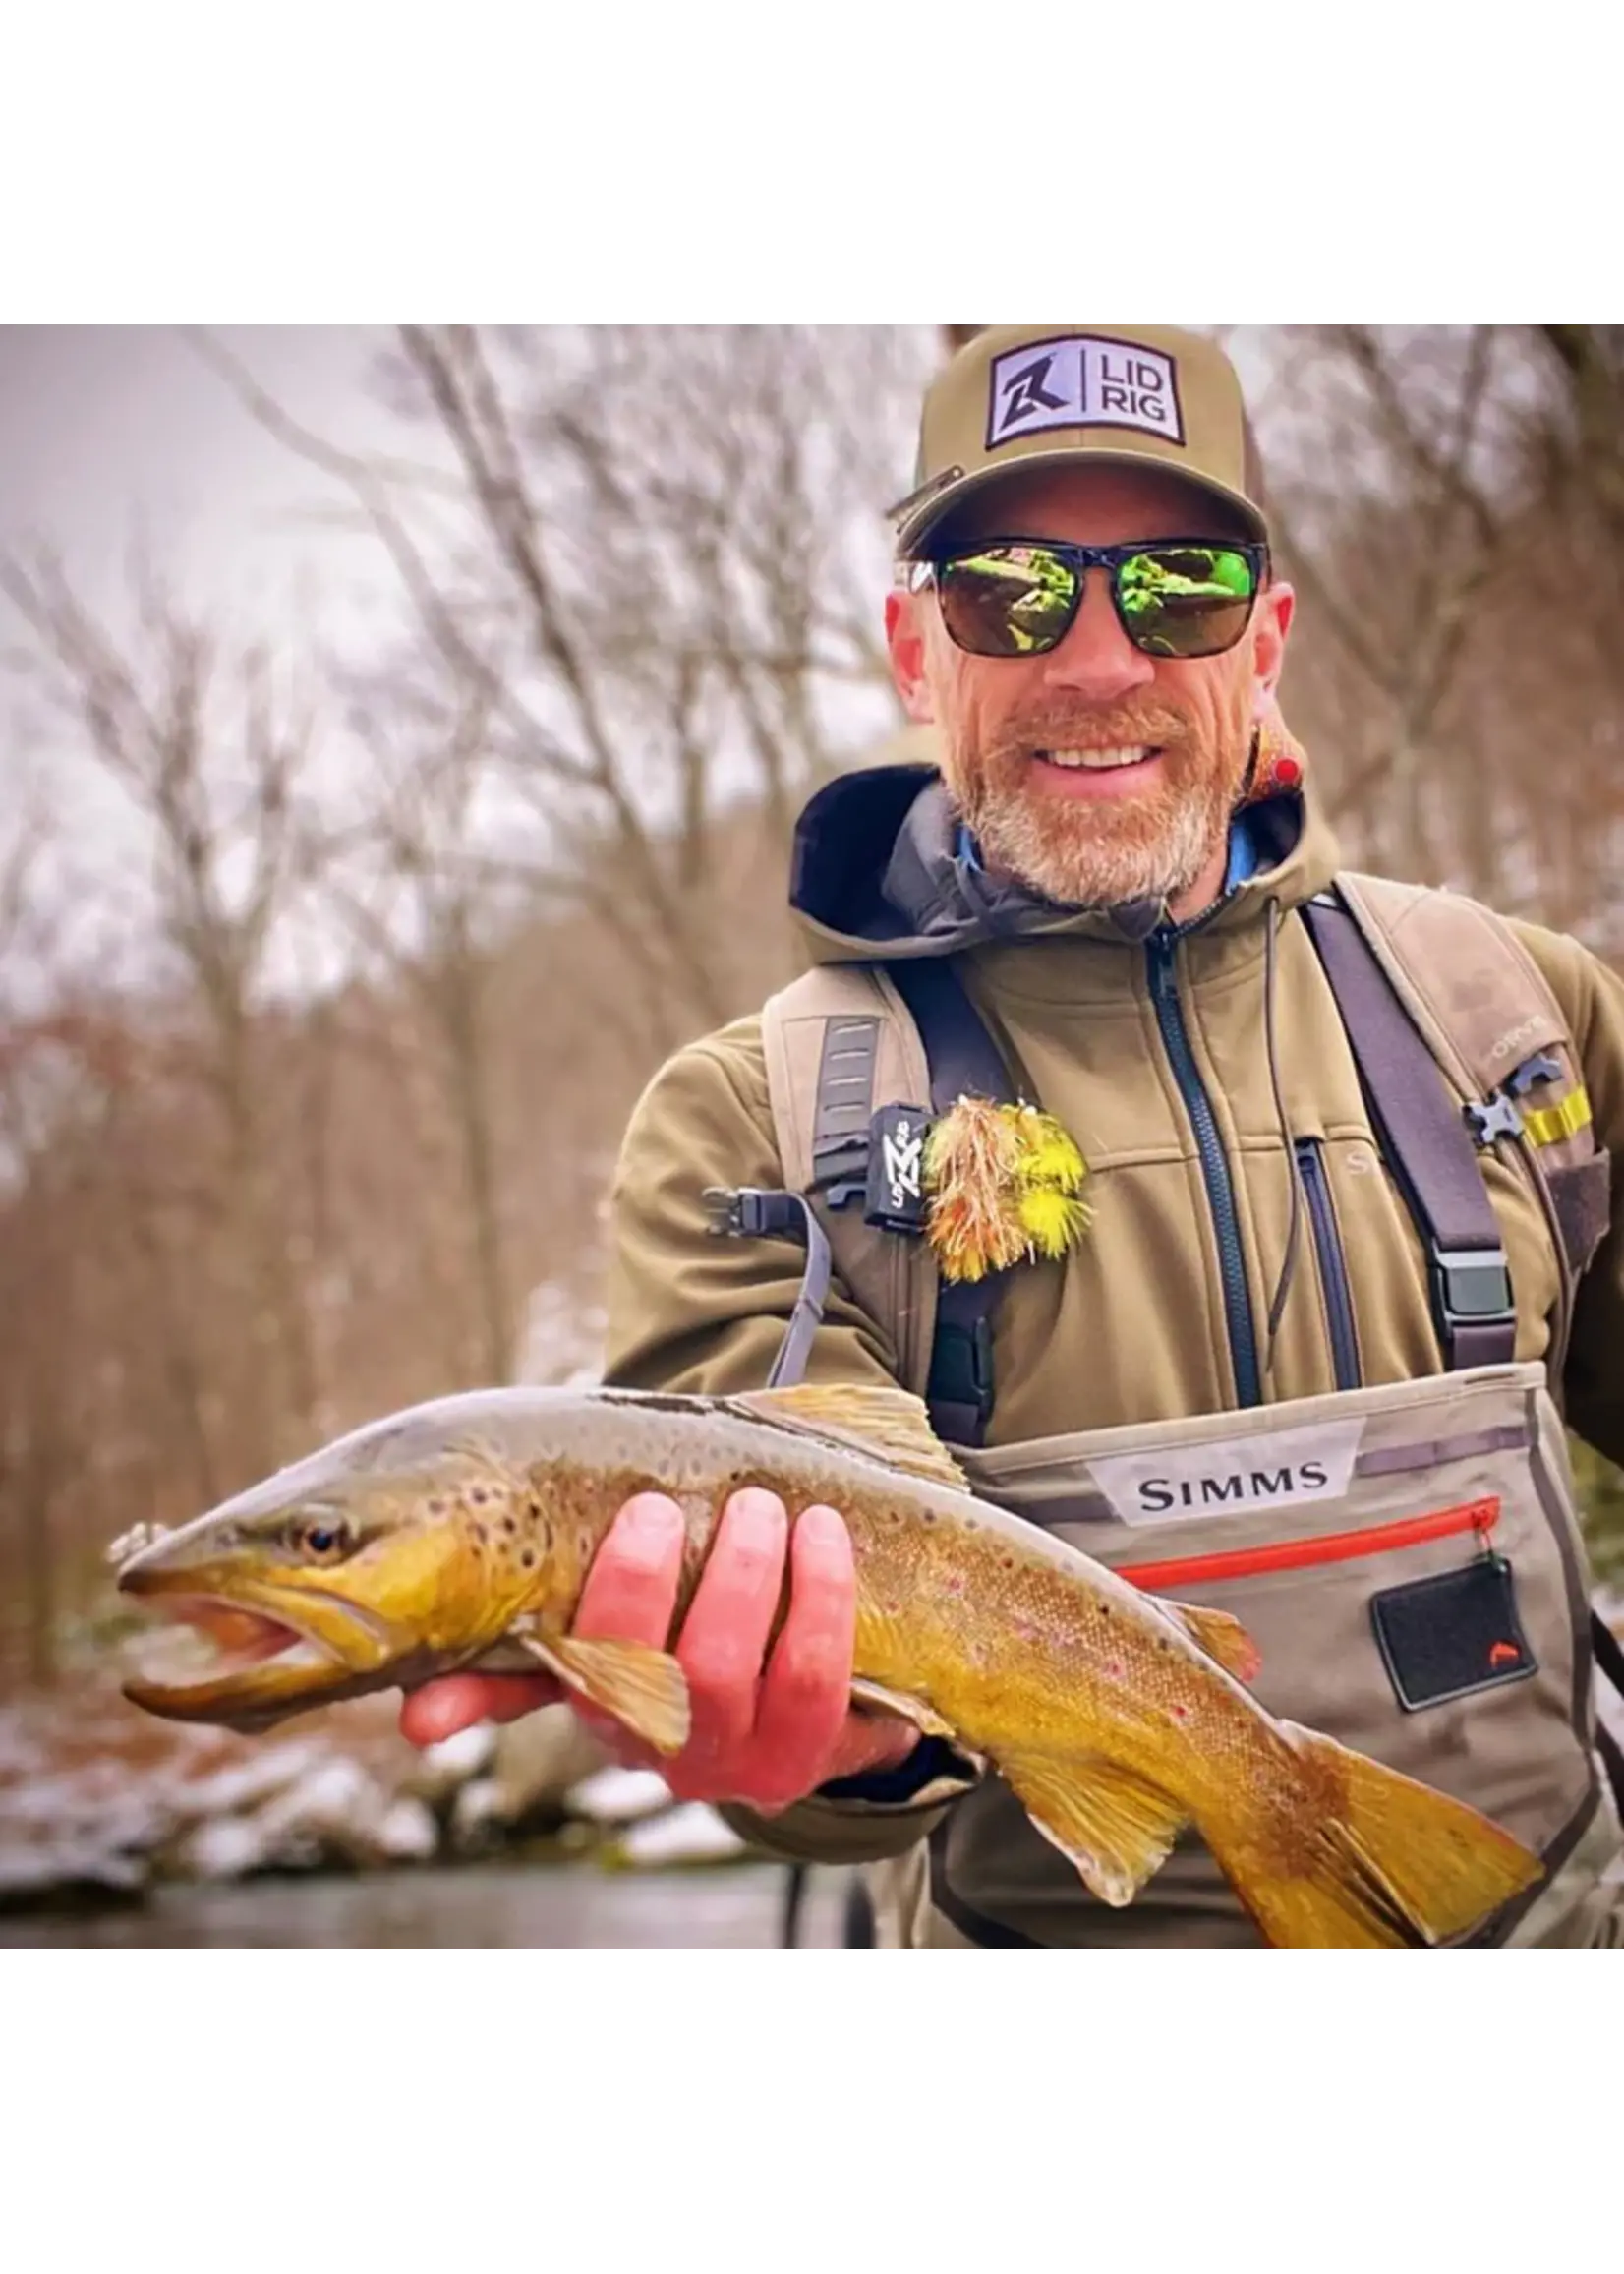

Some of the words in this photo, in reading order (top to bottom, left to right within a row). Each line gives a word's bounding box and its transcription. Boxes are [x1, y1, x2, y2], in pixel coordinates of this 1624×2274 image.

[1100, 353, 1164, 393] LID
[1100, 385, 1167, 423] RIG
[1137, 1460, 1329, 1512] SIMMS
